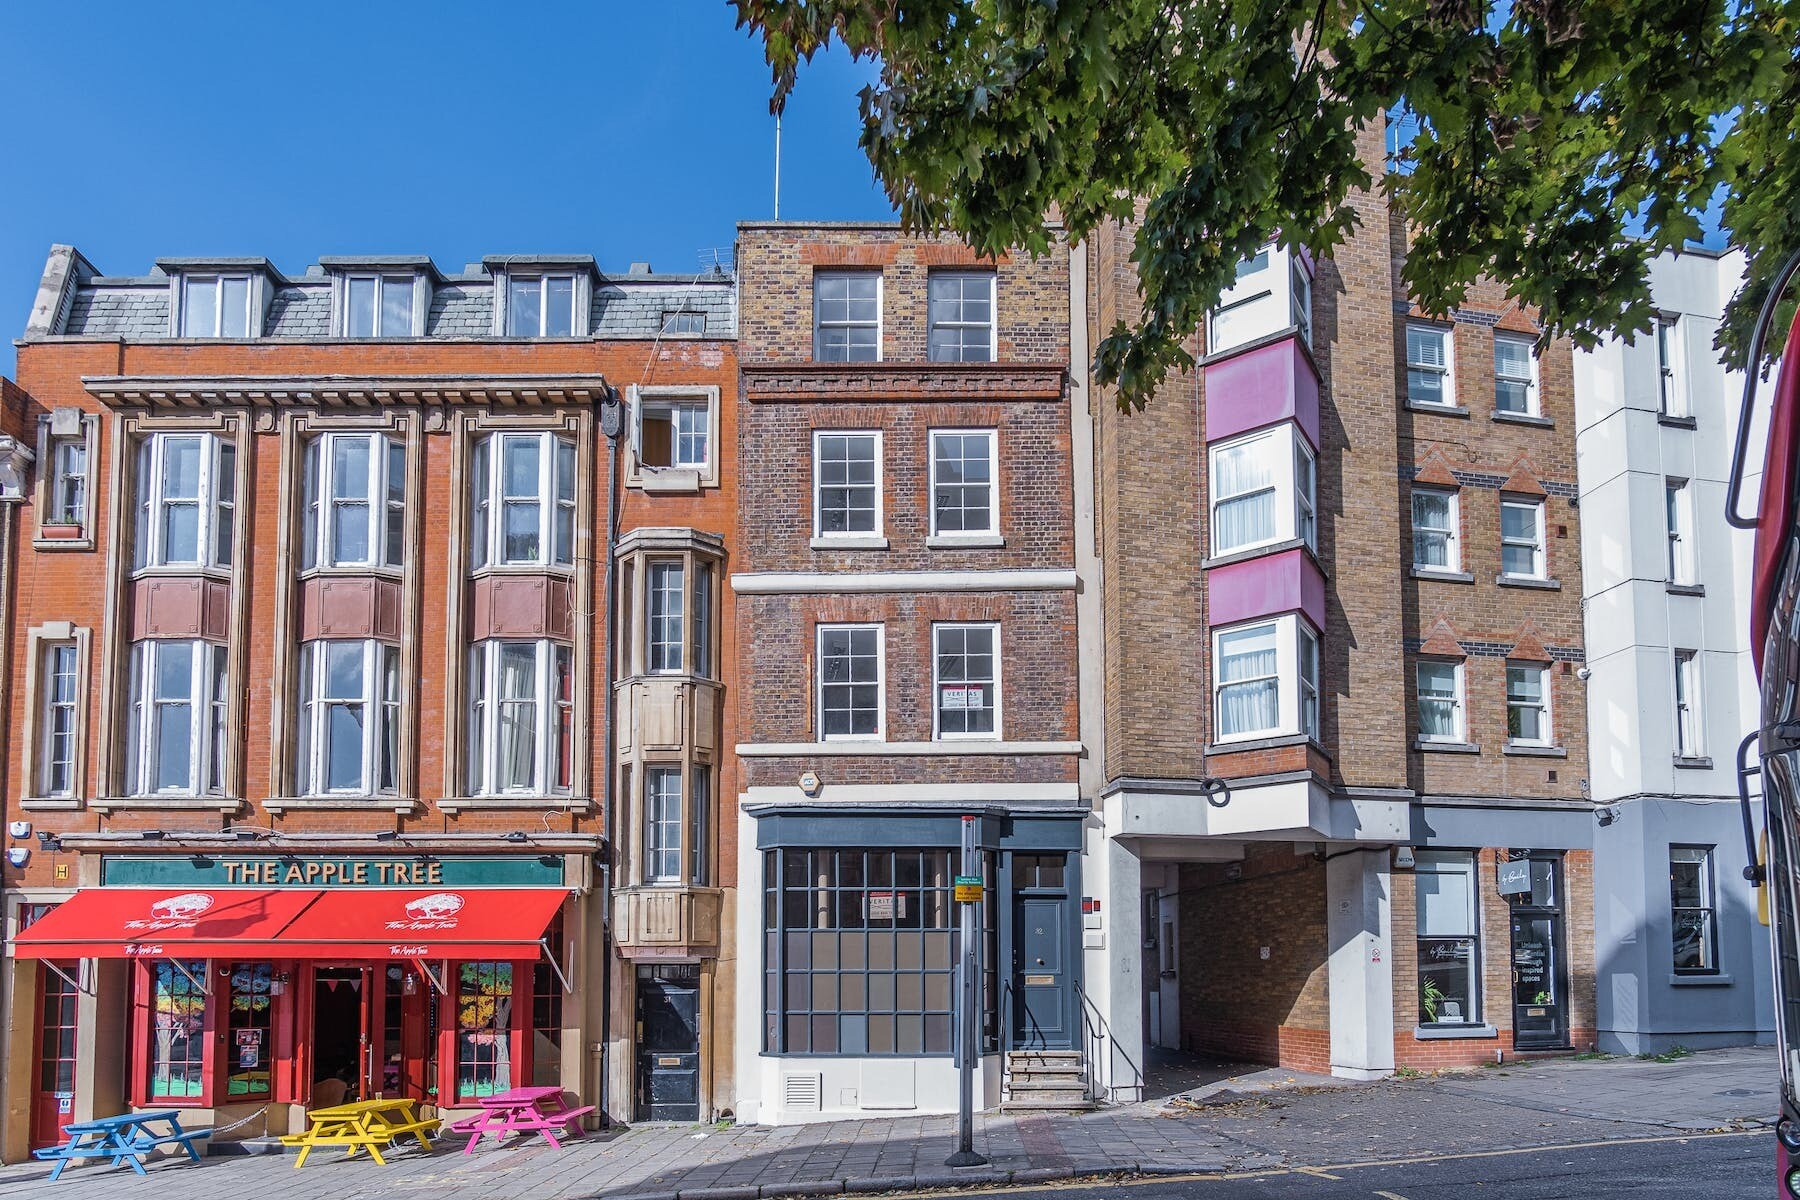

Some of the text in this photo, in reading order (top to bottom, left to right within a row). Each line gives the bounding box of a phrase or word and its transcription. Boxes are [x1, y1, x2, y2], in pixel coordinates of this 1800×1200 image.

[222, 862, 443, 884] THE APPLE TREE
[124, 919, 199, 929] The Apple Tree
[385, 918, 458, 930] The Apple Tree
[124, 944, 163, 954] The Apple Tree
[389, 944, 429, 955] The Apple Tree
